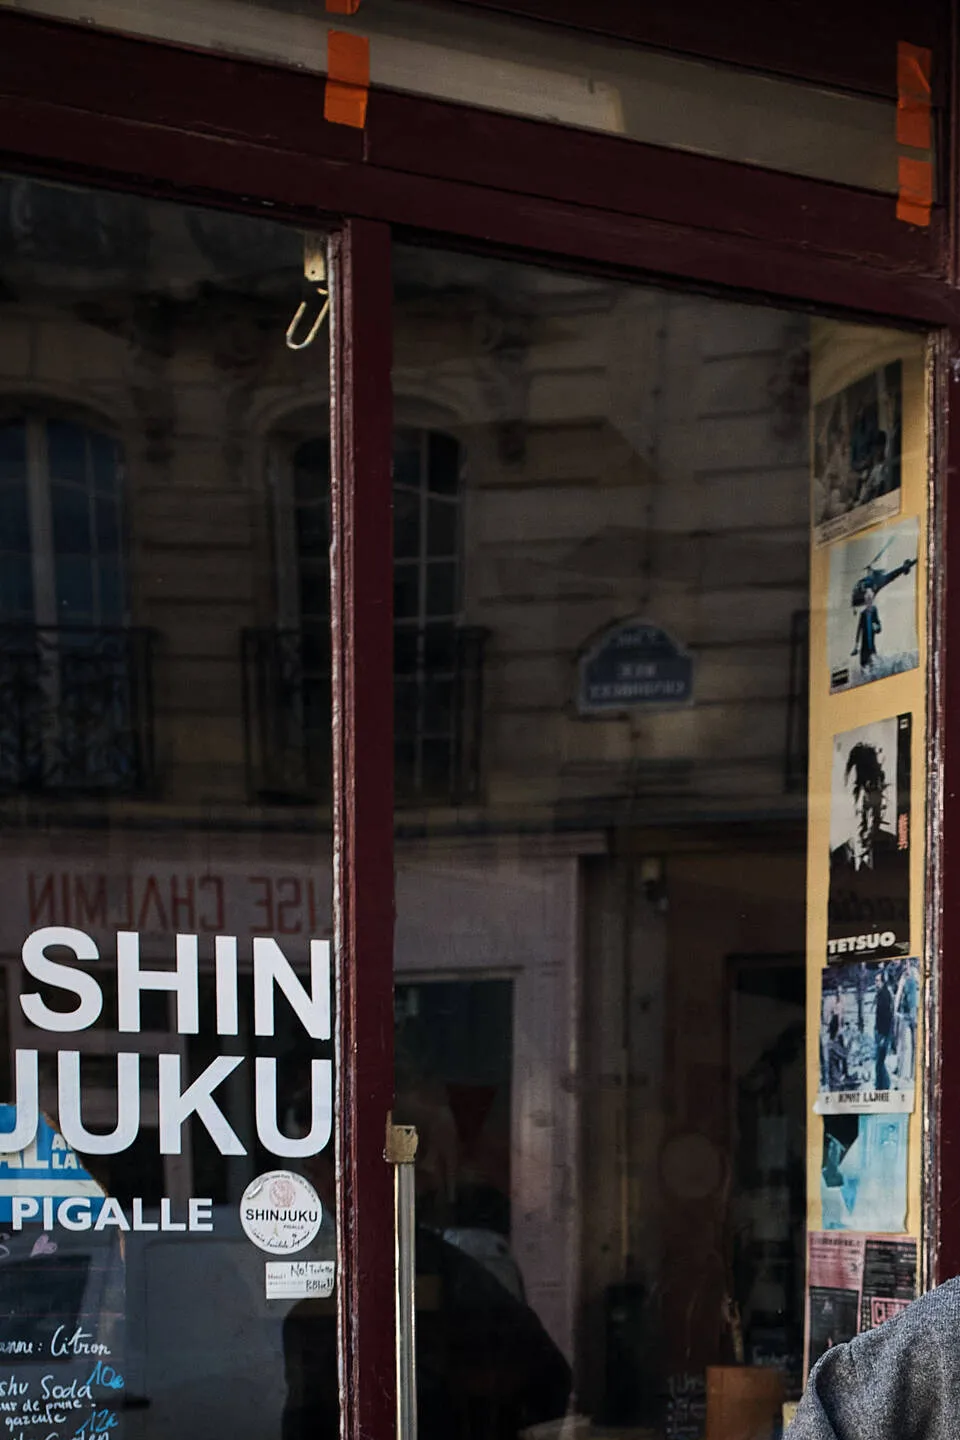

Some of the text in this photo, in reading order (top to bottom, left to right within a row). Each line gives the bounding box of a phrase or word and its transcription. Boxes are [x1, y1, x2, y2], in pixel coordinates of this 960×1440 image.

[827, 930, 896, 953] TETSUO
[19, 925, 331, 1041] SHIN
[0, 1048, 333, 1158] JUKU
[11, 1196, 214, 1232] PIGALLE
[245, 1209, 318, 1222] SHINJUKU
[50, 1325, 112, 1357] Citron
[41, 1374, 93, 1400] Soda
[22, 1399, 40, 1413] de
